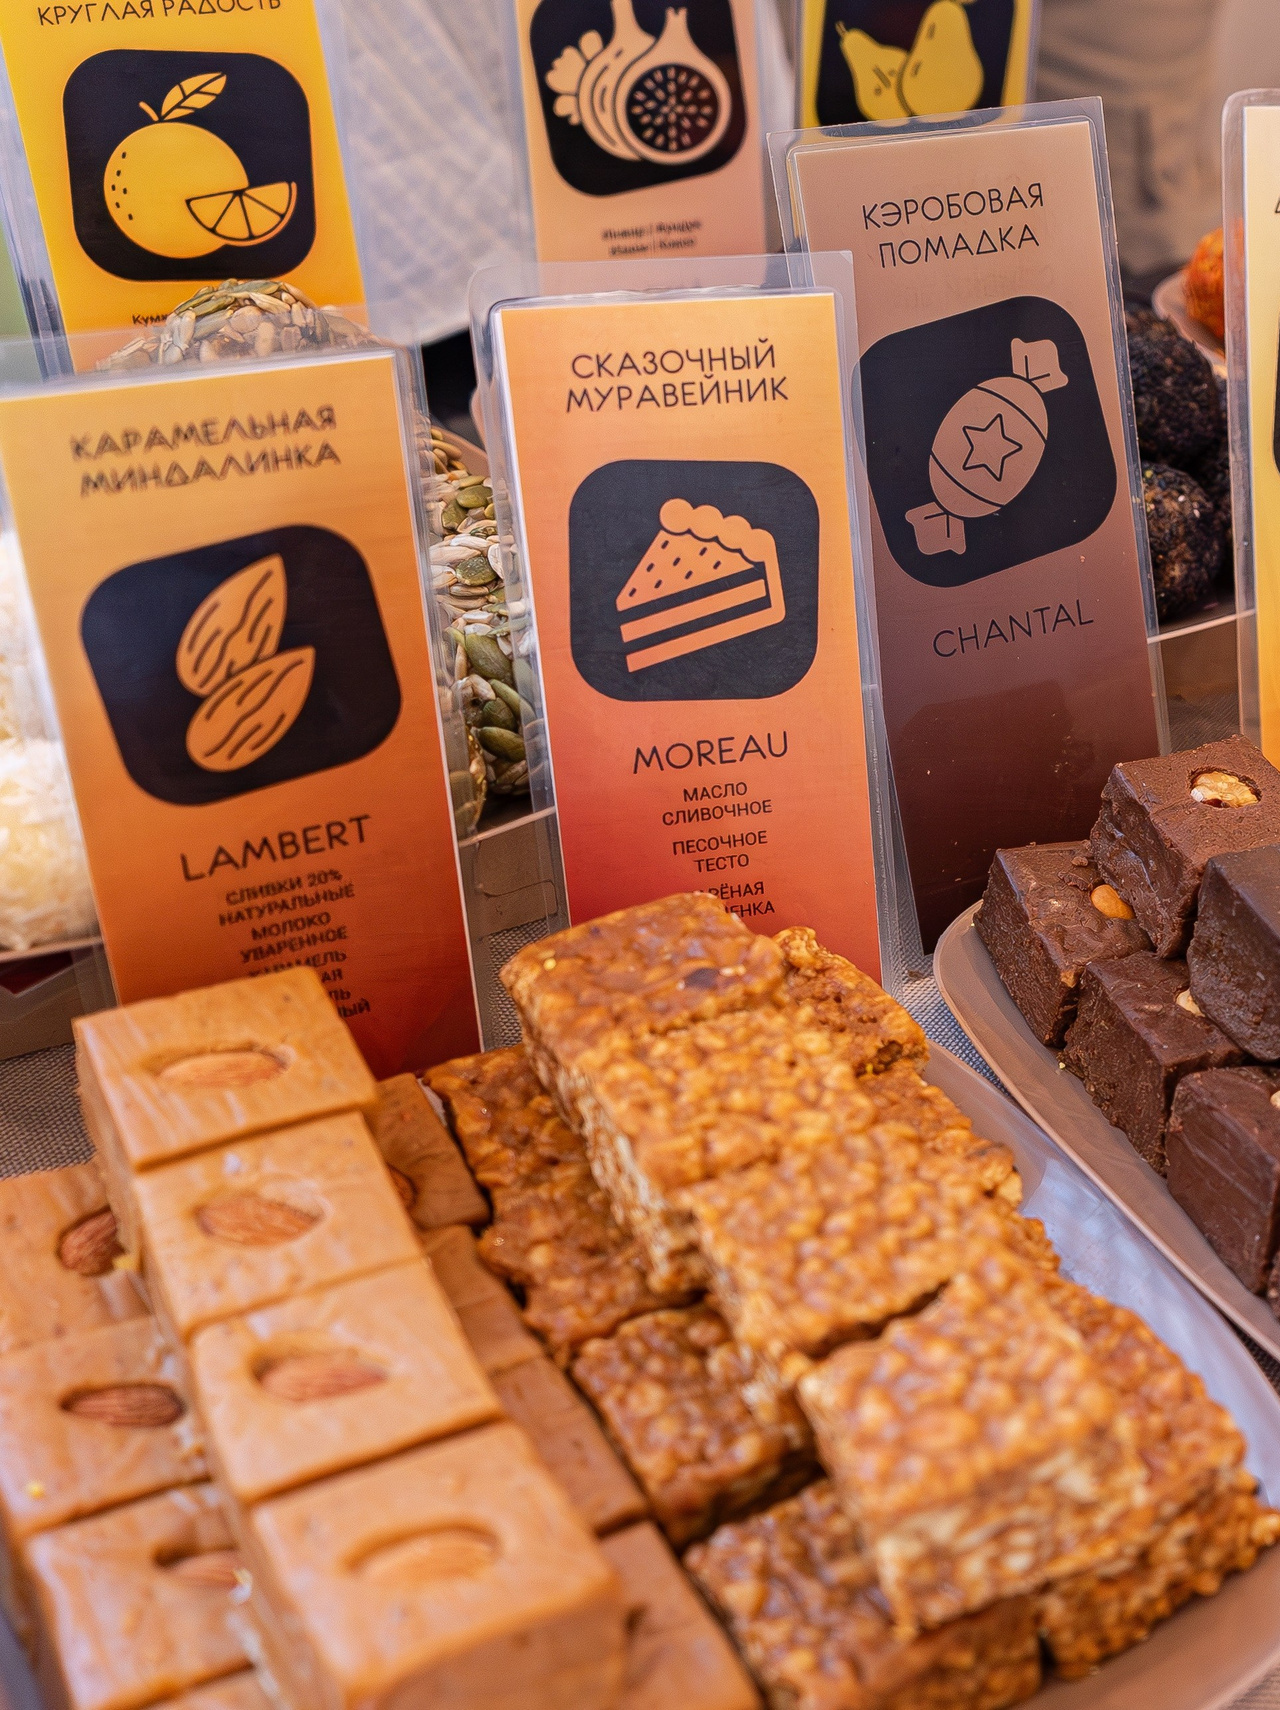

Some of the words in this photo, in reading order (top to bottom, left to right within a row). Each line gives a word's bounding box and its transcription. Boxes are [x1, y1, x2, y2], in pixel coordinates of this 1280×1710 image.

[37, 1, 154, 26] КРУГЛАЯ
[862, 182, 1043, 230] КЭРОБОВАЯ
[879, 224, 1040, 268] ПОМАДКА
[571, 337, 775, 379] СКАЗОЧНЫЙ
[566, 374, 788, 413] МУРАВЕЙНИК
[69, 403, 337, 462] КАРАМЕЛЬНАЯ
[80, 440, 342, 498] МИНДАЛИНКА
[933, 599, 1094, 657] CHANTAL
[633, 731, 788, 774] MOREAU
[683, 781, 748, 802] МАСЛО
[662, 799, 773, 826] СЛИВОЧНОЕ
[180, 814, 371, 882] LAMBERT
[672, 830, 768, 855] ПЕСОЧНОЕ
[694, 853, 749, 873] ТЕСТО
[218, 883, 355, 926] НАТУРАЛЬНЫЕ
[225, 876, 303, 906] СЛИВКИ
[307, 869, 343, 888] 20%
[699, 881, 764, 900] РЁНАЯ
[250, 911, 331, 940] МОЛОКО
